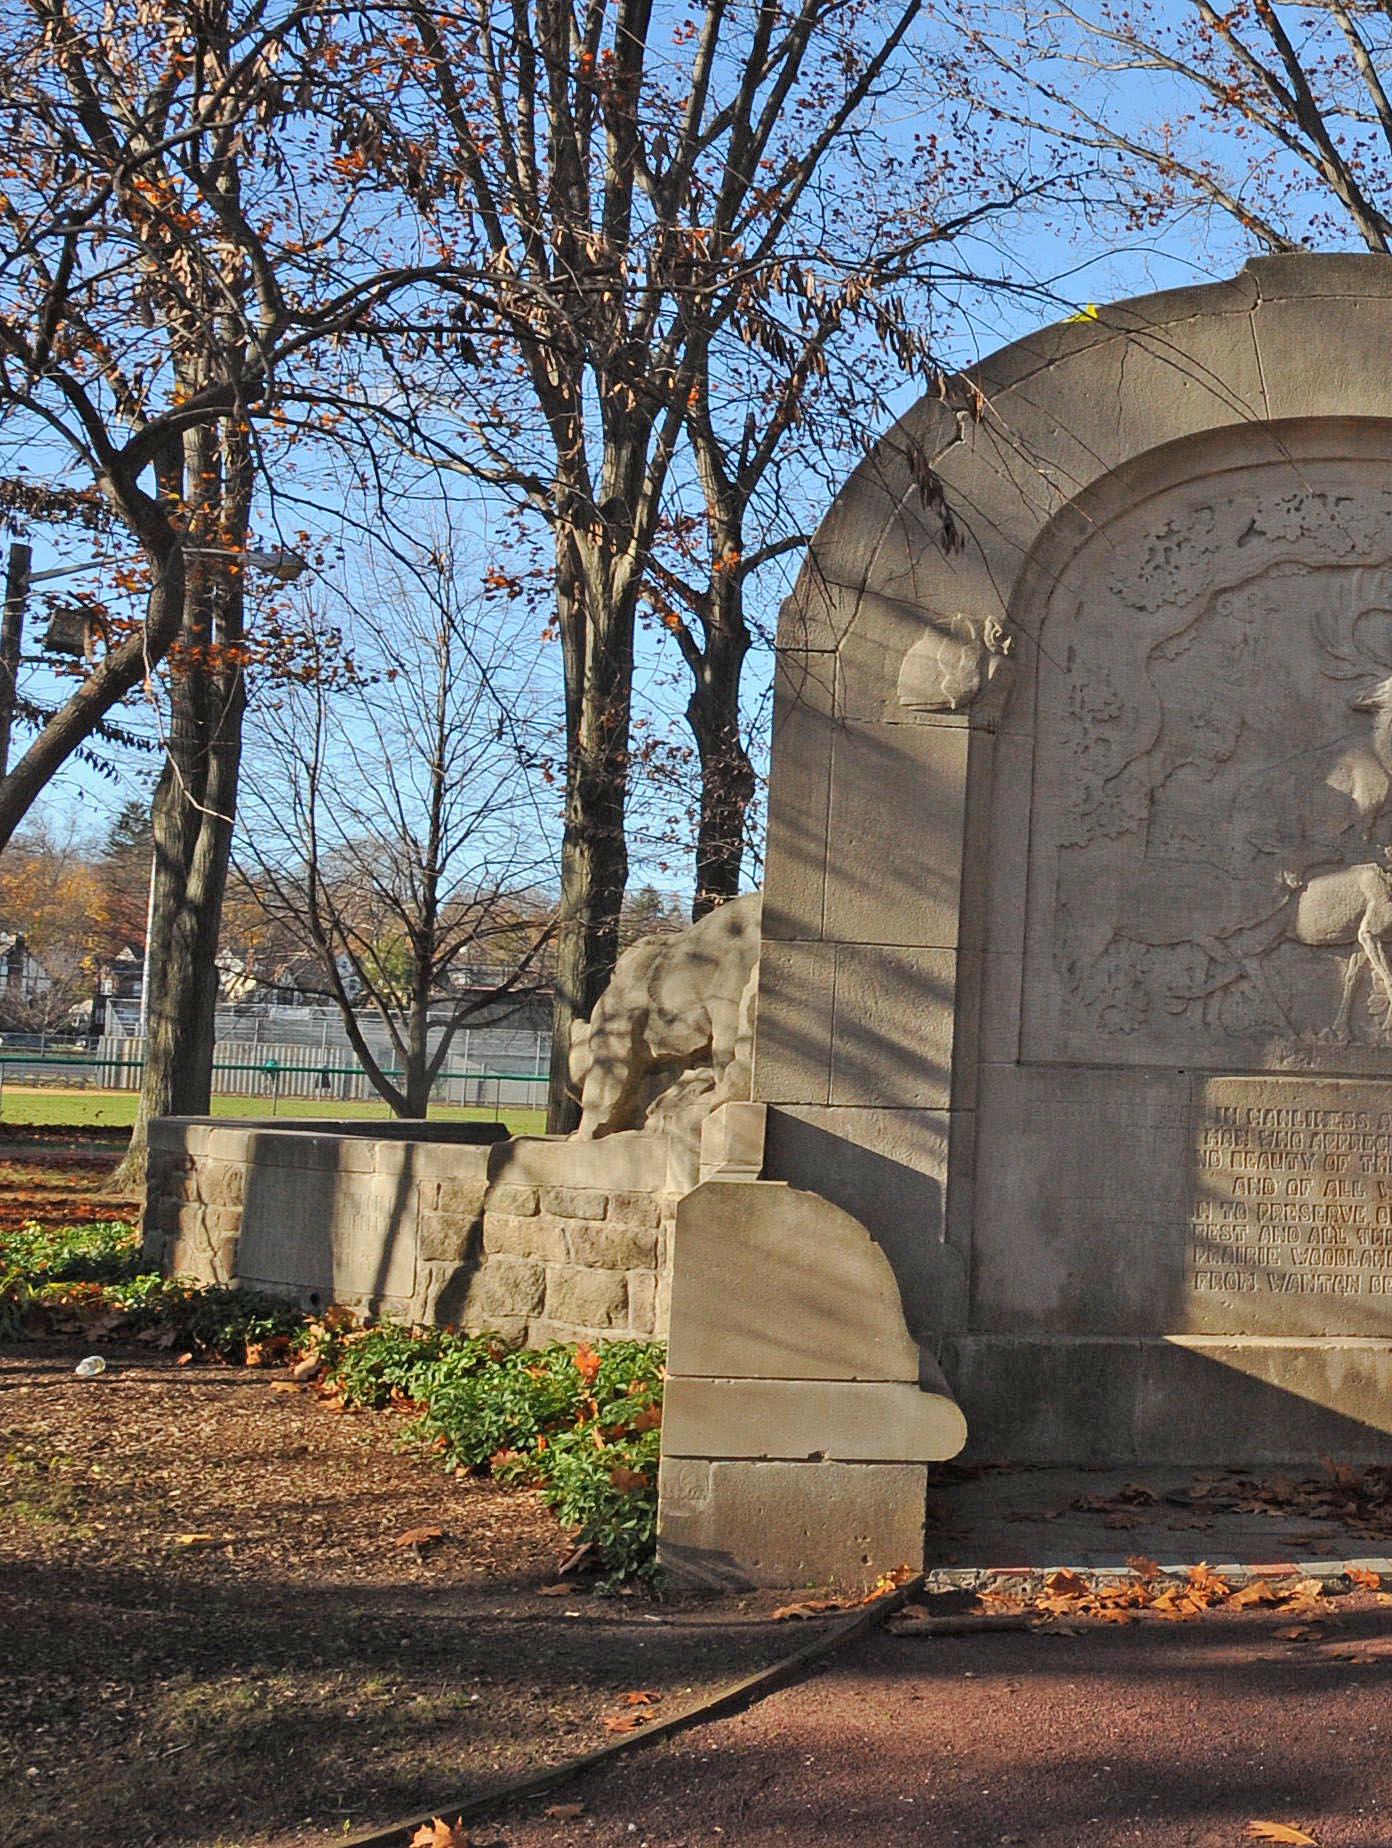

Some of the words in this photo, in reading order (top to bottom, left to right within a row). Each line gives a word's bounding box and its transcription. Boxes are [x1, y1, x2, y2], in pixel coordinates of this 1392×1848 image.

[1246, 1107, 1371, 1130] MANLINESS
[1229, 1150, 1319, 1172] BEAUTY
[1323, 1152, 1352, 1173] OF
[1231, 1175, 1278, 1196] AND
[1285, 1177, 1314, 1198] OF
[1322, 1178, 1366, 1199] ALL
[1219, 1200, 1249, 1221] TO
[1256, 1202, 1367, 1225] PRESERVE
[1257, 1224, 1302, 1245] AND
[1307, 1225, 1348, 1246] ALL
[1192, 1245, 1282, 1267] PRAIRIE
[1194, 1270, 1257, 1292] FROM
[1266, 1271, 1363, 1296] WANTON
